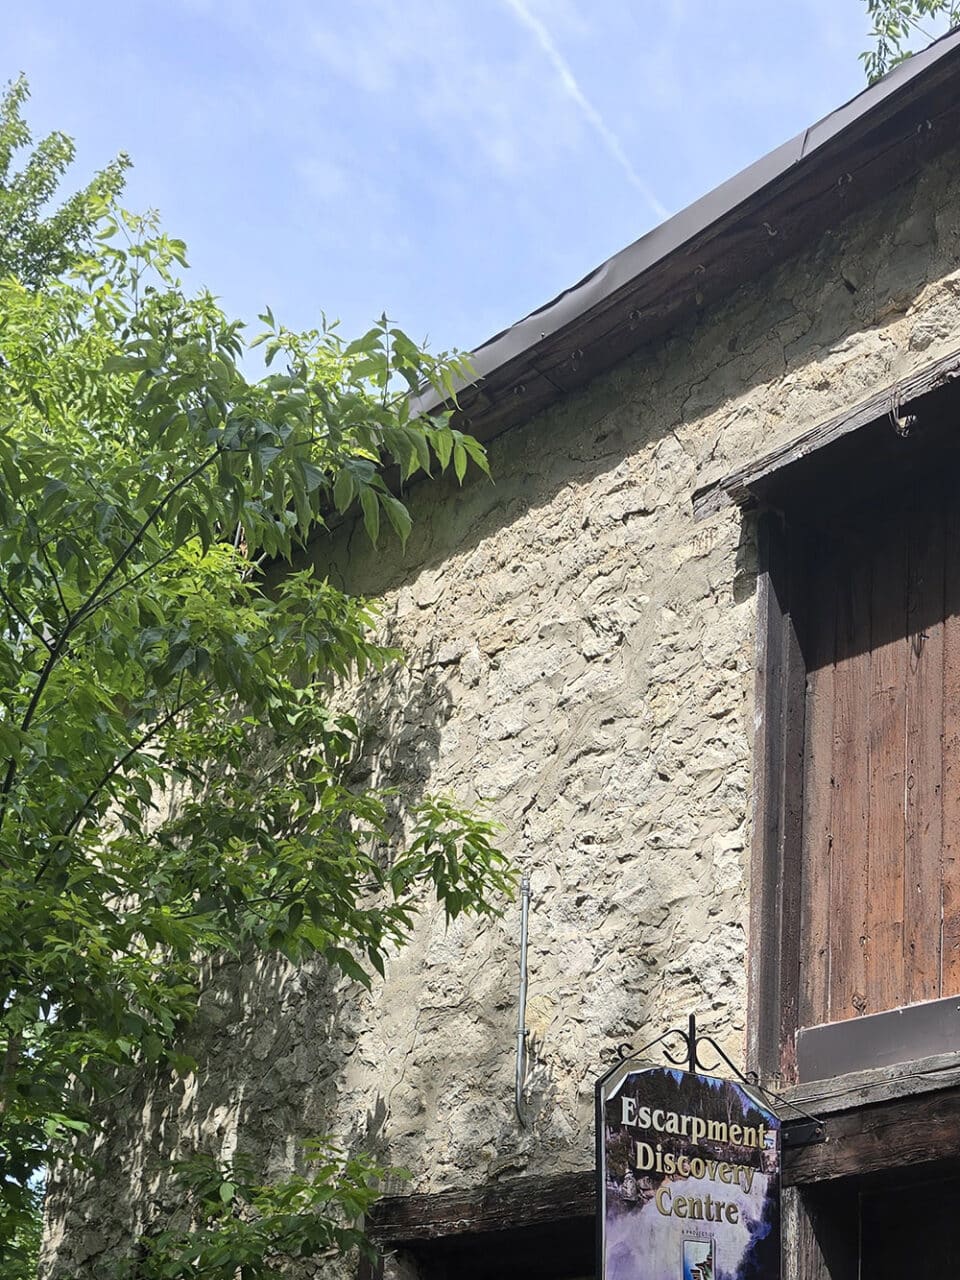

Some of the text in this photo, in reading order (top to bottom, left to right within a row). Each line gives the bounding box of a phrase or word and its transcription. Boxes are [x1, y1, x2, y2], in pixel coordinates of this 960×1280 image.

[621, 1096, 767, 1150] Escarpment
[636, 1141, 755, 1194] Discovery
[655, 1186, 739, 1225] Centre
